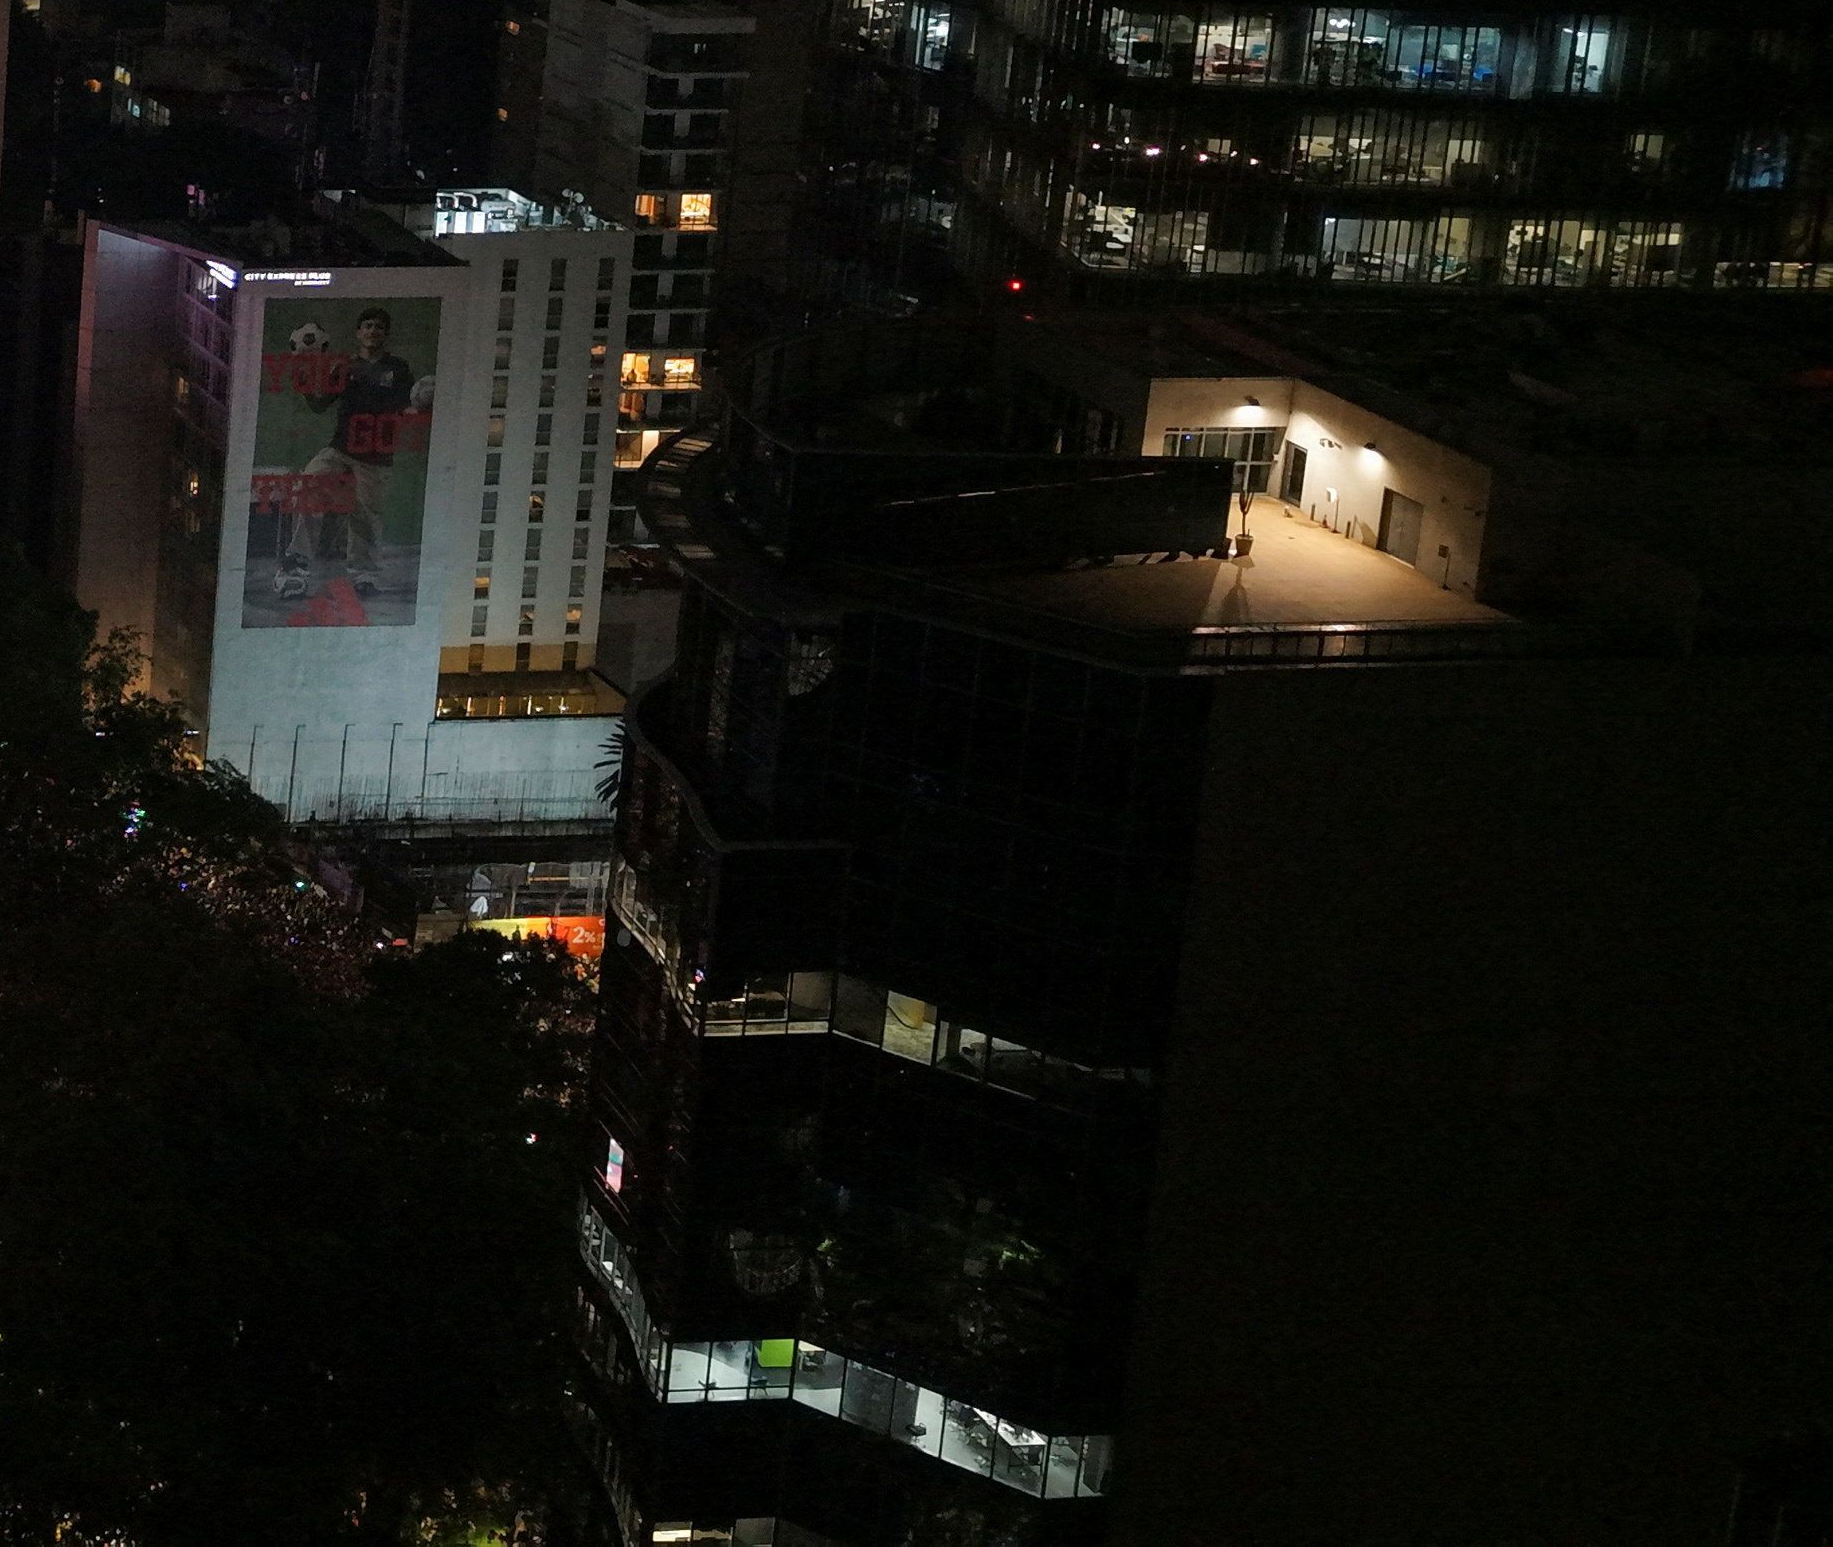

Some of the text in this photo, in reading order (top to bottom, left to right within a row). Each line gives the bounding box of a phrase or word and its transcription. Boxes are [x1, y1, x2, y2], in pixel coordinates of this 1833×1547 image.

[262, 353, 351, 394] YOU
[346, 411, 433, 454] GOT
[572, 926, 596, 944] 2%
